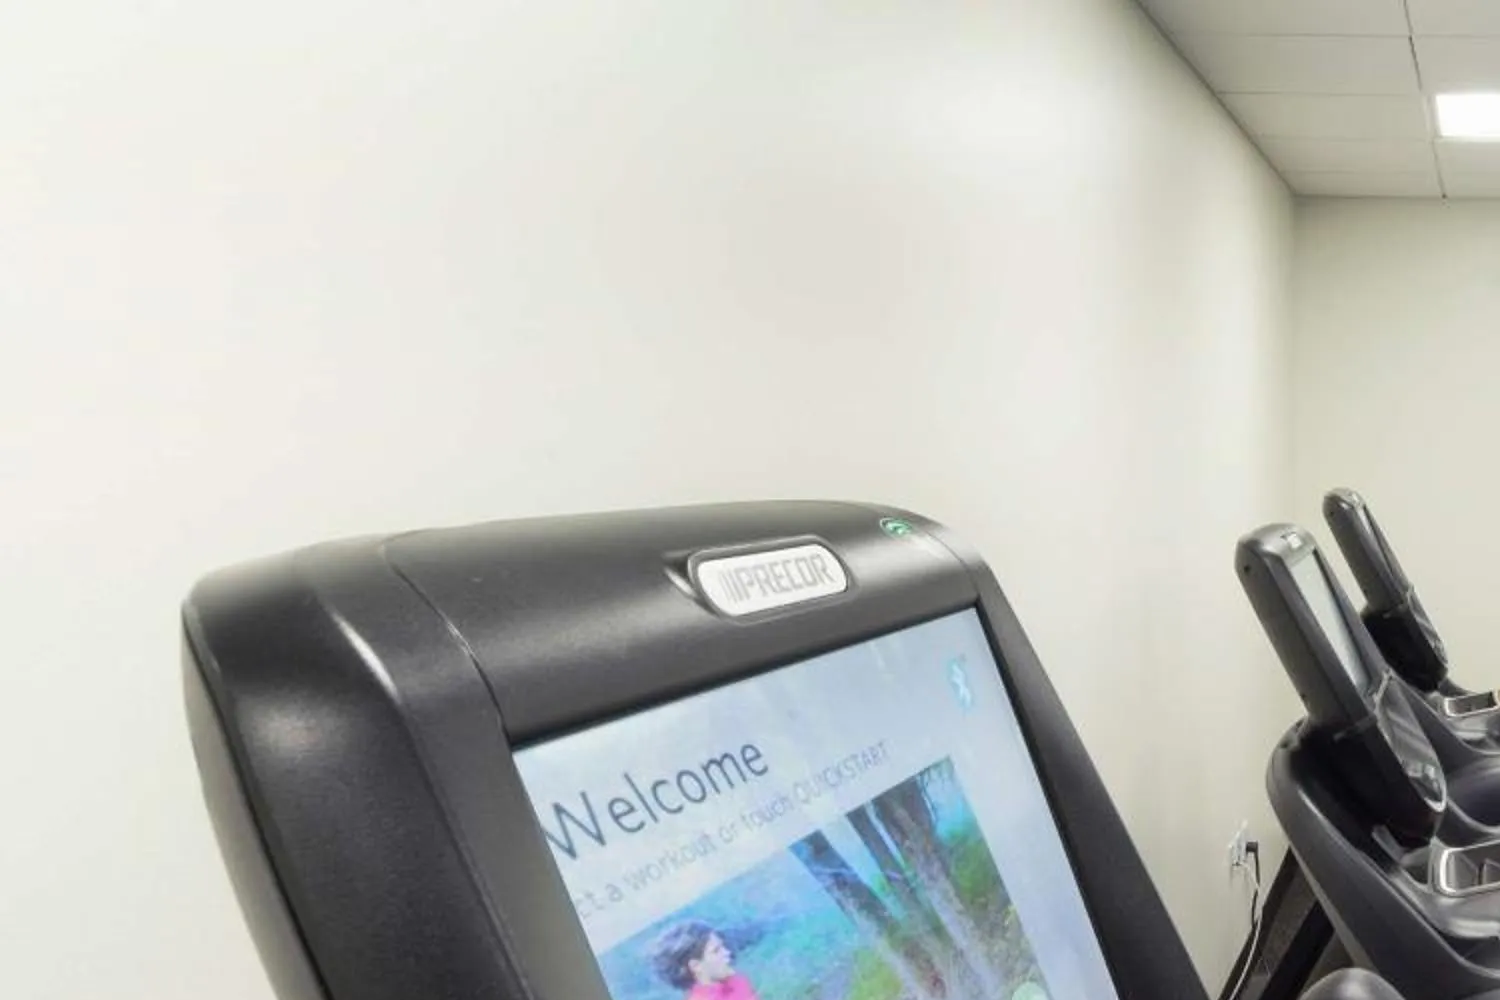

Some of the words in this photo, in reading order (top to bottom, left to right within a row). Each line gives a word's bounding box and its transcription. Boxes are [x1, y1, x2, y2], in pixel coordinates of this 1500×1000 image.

[733, 553, 836, 602] PRECOR
[541, 743, 769, 861] Welcome
[605, 882, 625, 903] a
[624, 832, 716, 891] workout
[717, 822, 740, 845] or
[741, 793, 794, 832] touch
